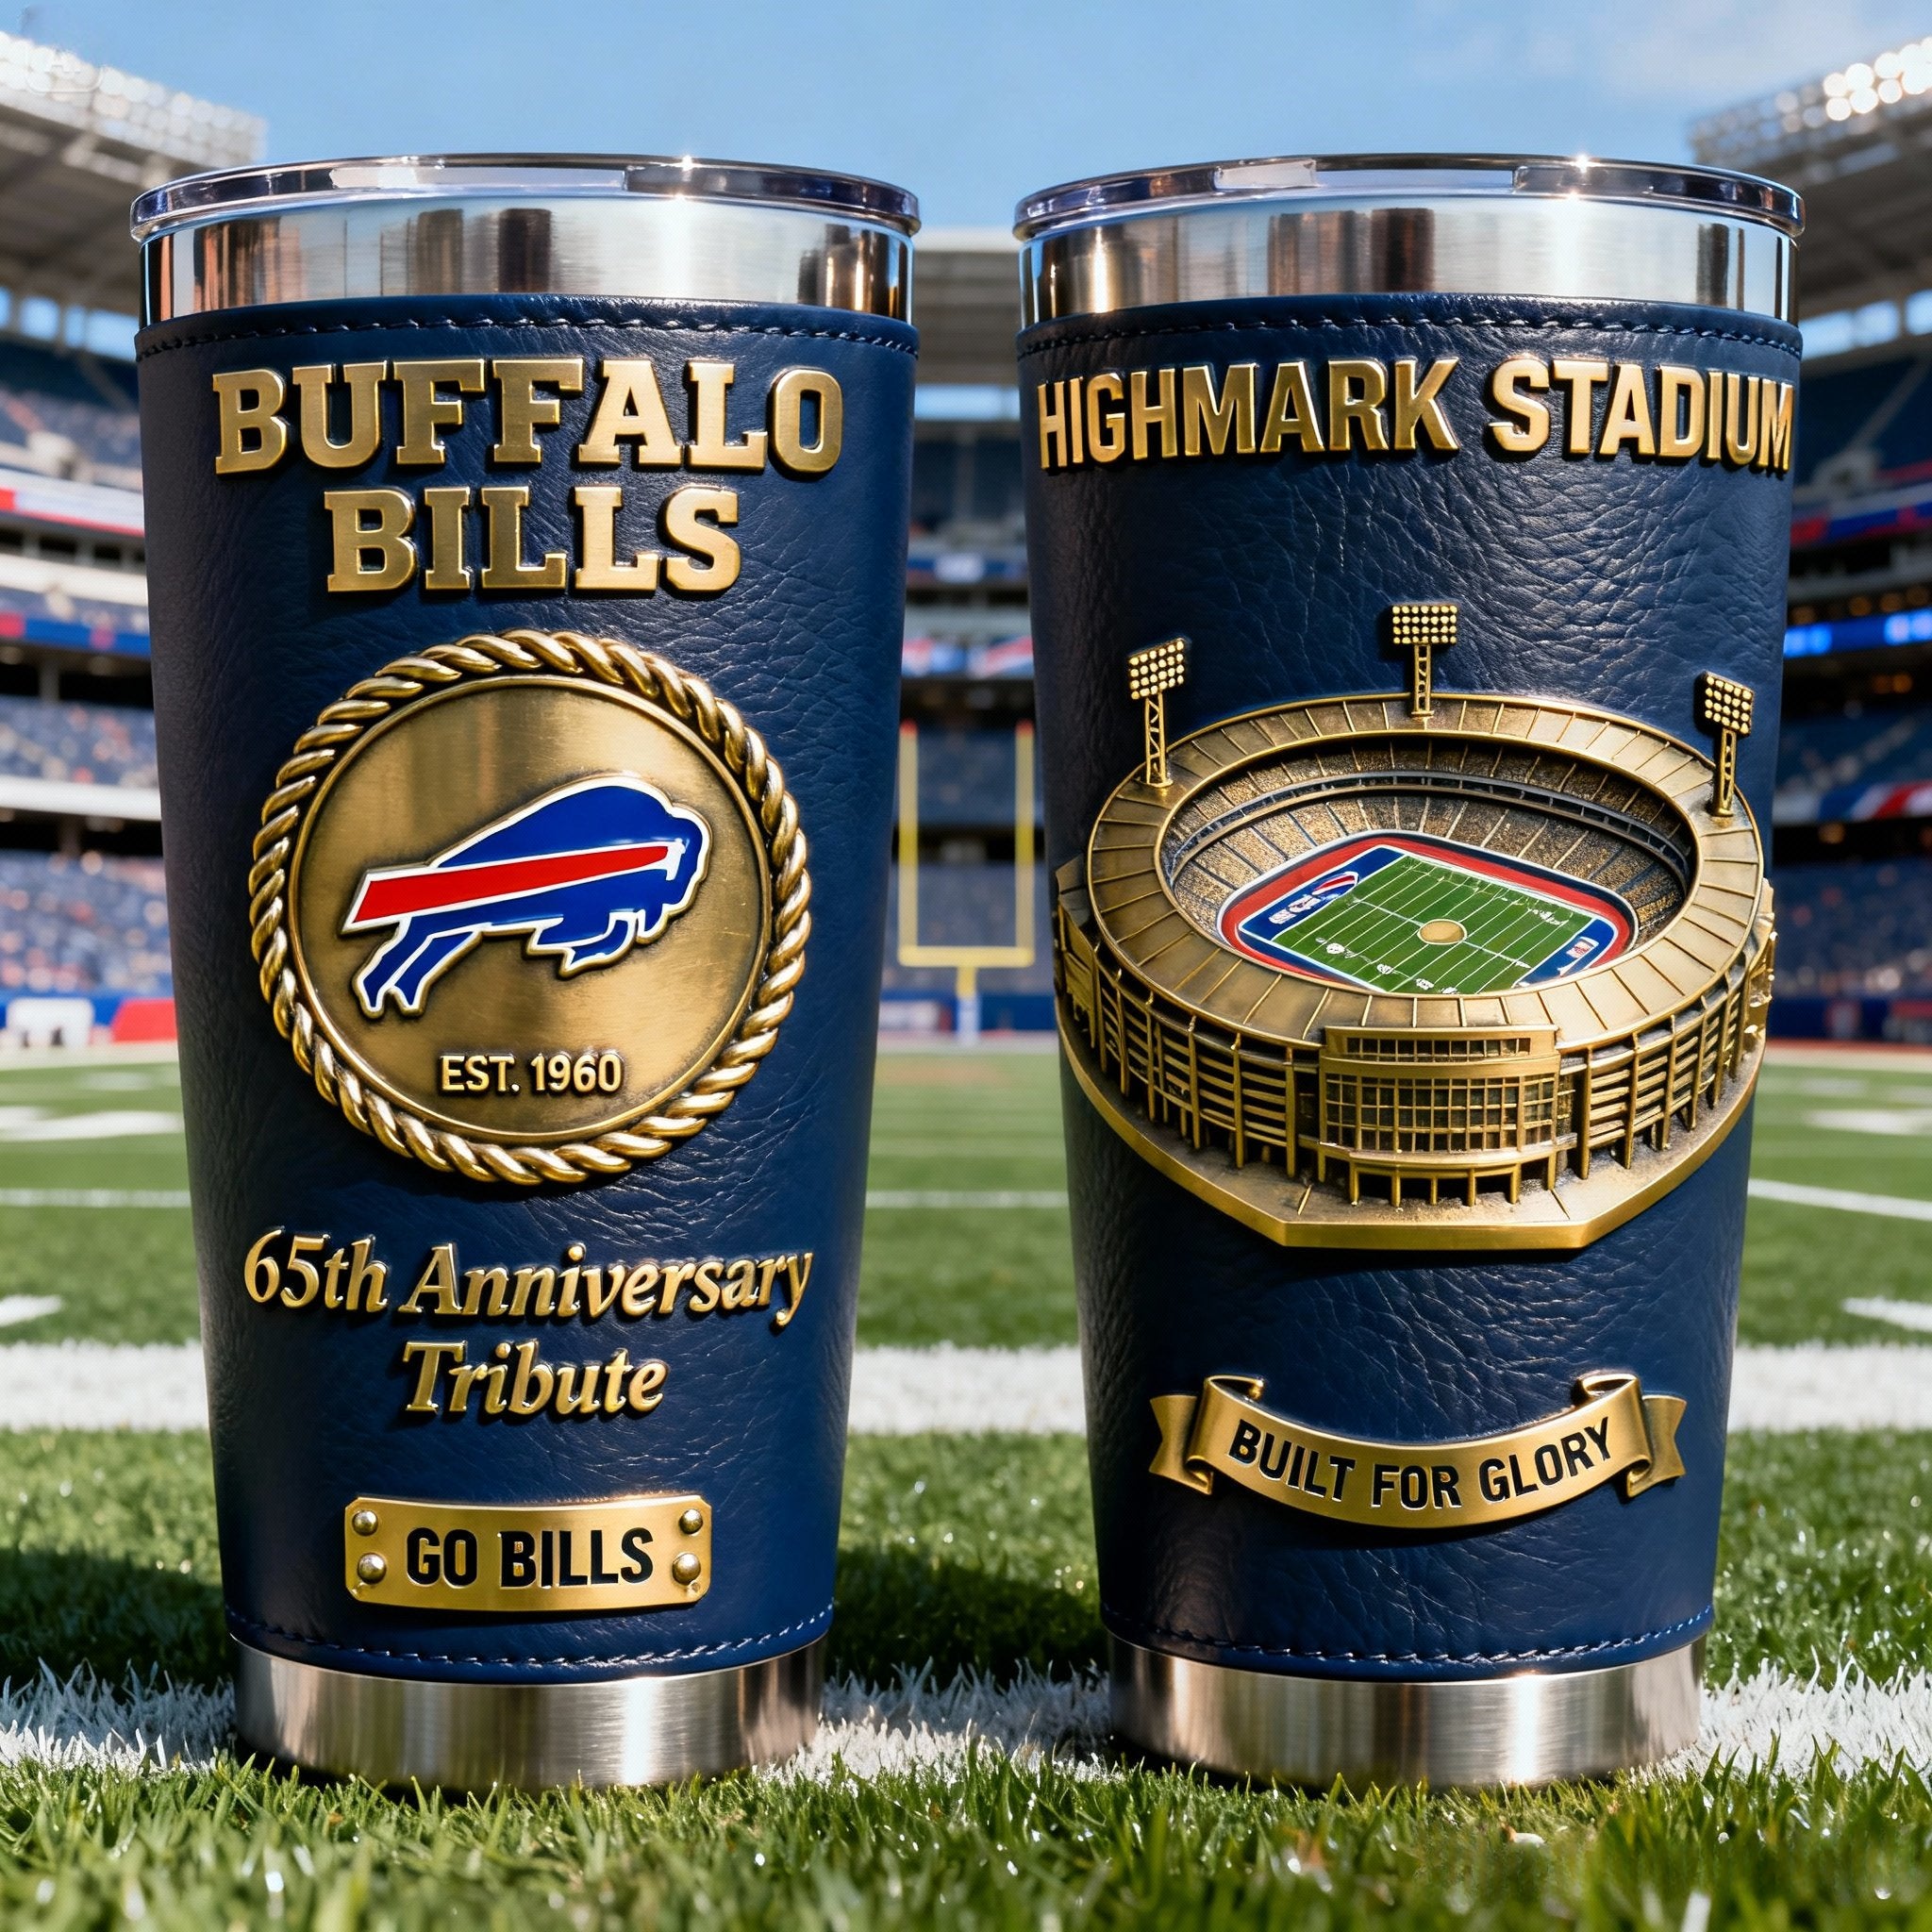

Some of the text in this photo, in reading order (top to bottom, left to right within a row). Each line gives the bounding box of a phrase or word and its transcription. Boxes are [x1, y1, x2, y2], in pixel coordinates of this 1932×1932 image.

[212, 358, 842, 475] BUFFALO
[1037, 355, 1794, 474] HIGHMARK STADIUM
[324, 485, 741, 593] BILLS
[441, 1053, 624, 1093] EST. 1960
[243, 1227, 814, 1327] 65th Anniversary
[403, 1339, 670, 1417] Tribute
[1228, 1416, 1612, 1509] BUILT FOR GLORY
[406, 1526, 655, 1589] GO BILLS
